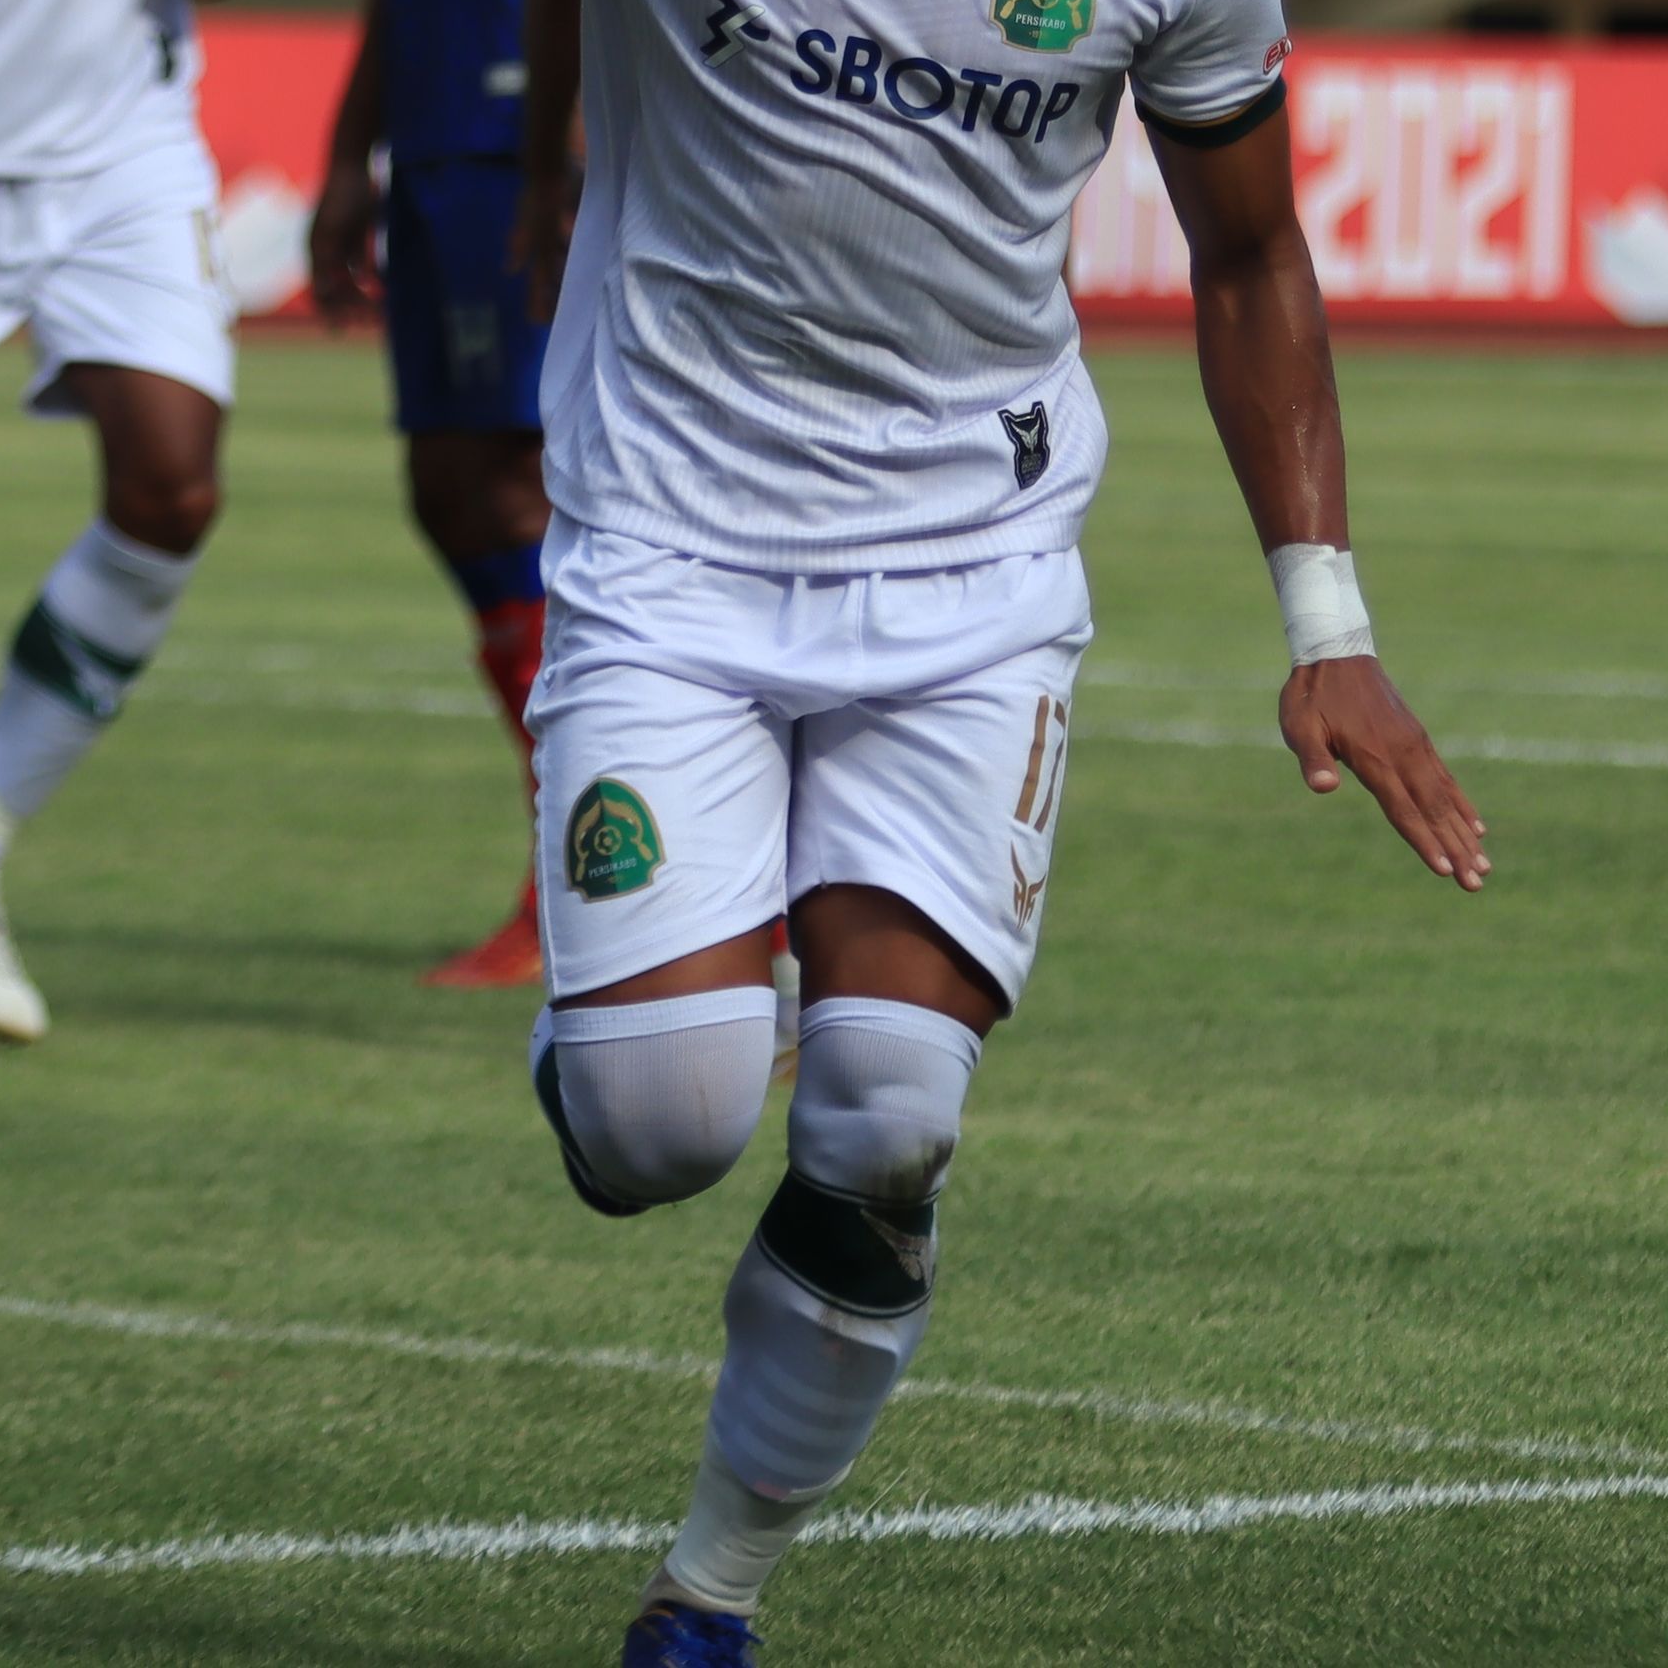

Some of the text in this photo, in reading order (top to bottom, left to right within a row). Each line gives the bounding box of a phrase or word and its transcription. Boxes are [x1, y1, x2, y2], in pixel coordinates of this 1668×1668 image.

[1015, 12, 1067, 31] PERSIKABO
[789, 28, 1081, 144] SBOTOP
[1300, 65, 1572, 298] 2021
